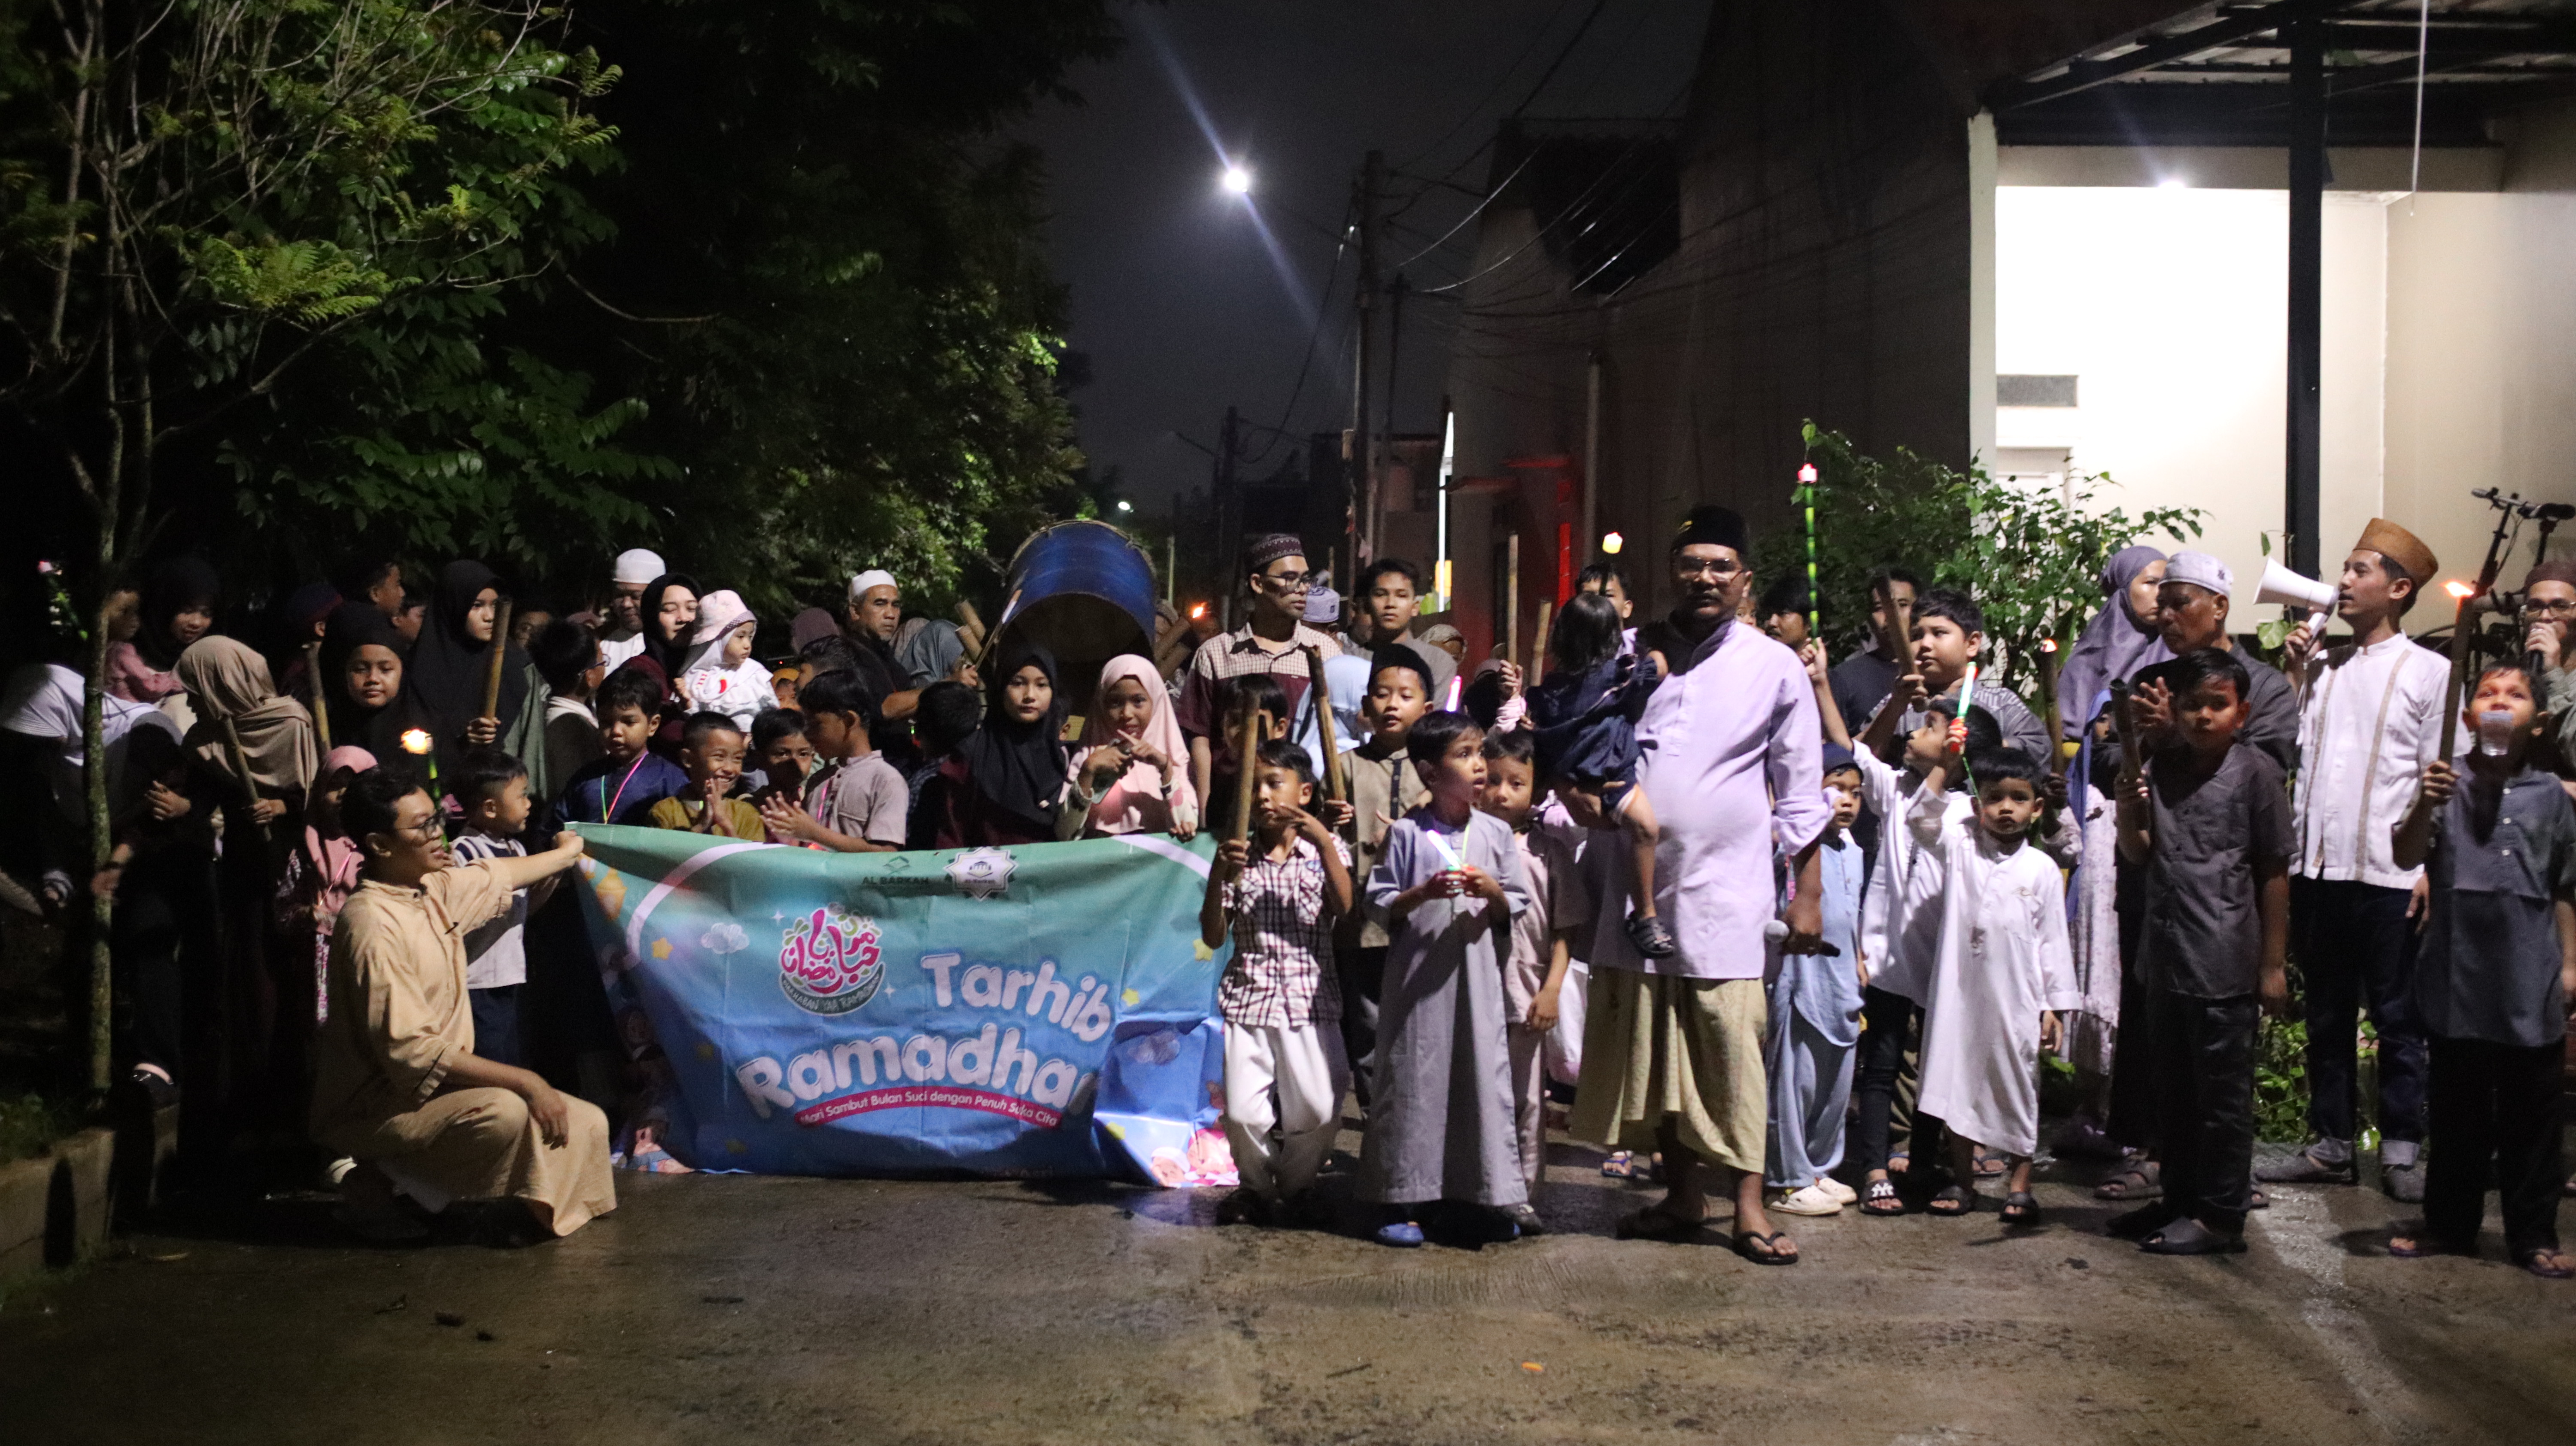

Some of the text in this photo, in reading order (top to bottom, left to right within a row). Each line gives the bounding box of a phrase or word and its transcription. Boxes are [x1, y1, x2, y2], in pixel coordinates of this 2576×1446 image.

[862, 877, 877, 885] AL
[921, 953, 1111, 1042] Tarhib
[825, 1097, 868, 1116] Sambut
[871, 1093, 902, 1106] Bulan
[905, 1091, 927, 1102] Suci
[930, 1091, 972, 1106] dengan
[975, 1095, 1007, 1110] Penuh
[1008, 1102, 1033, 1118] Suka
[1035, 1111, 1058, 1127] Cita
